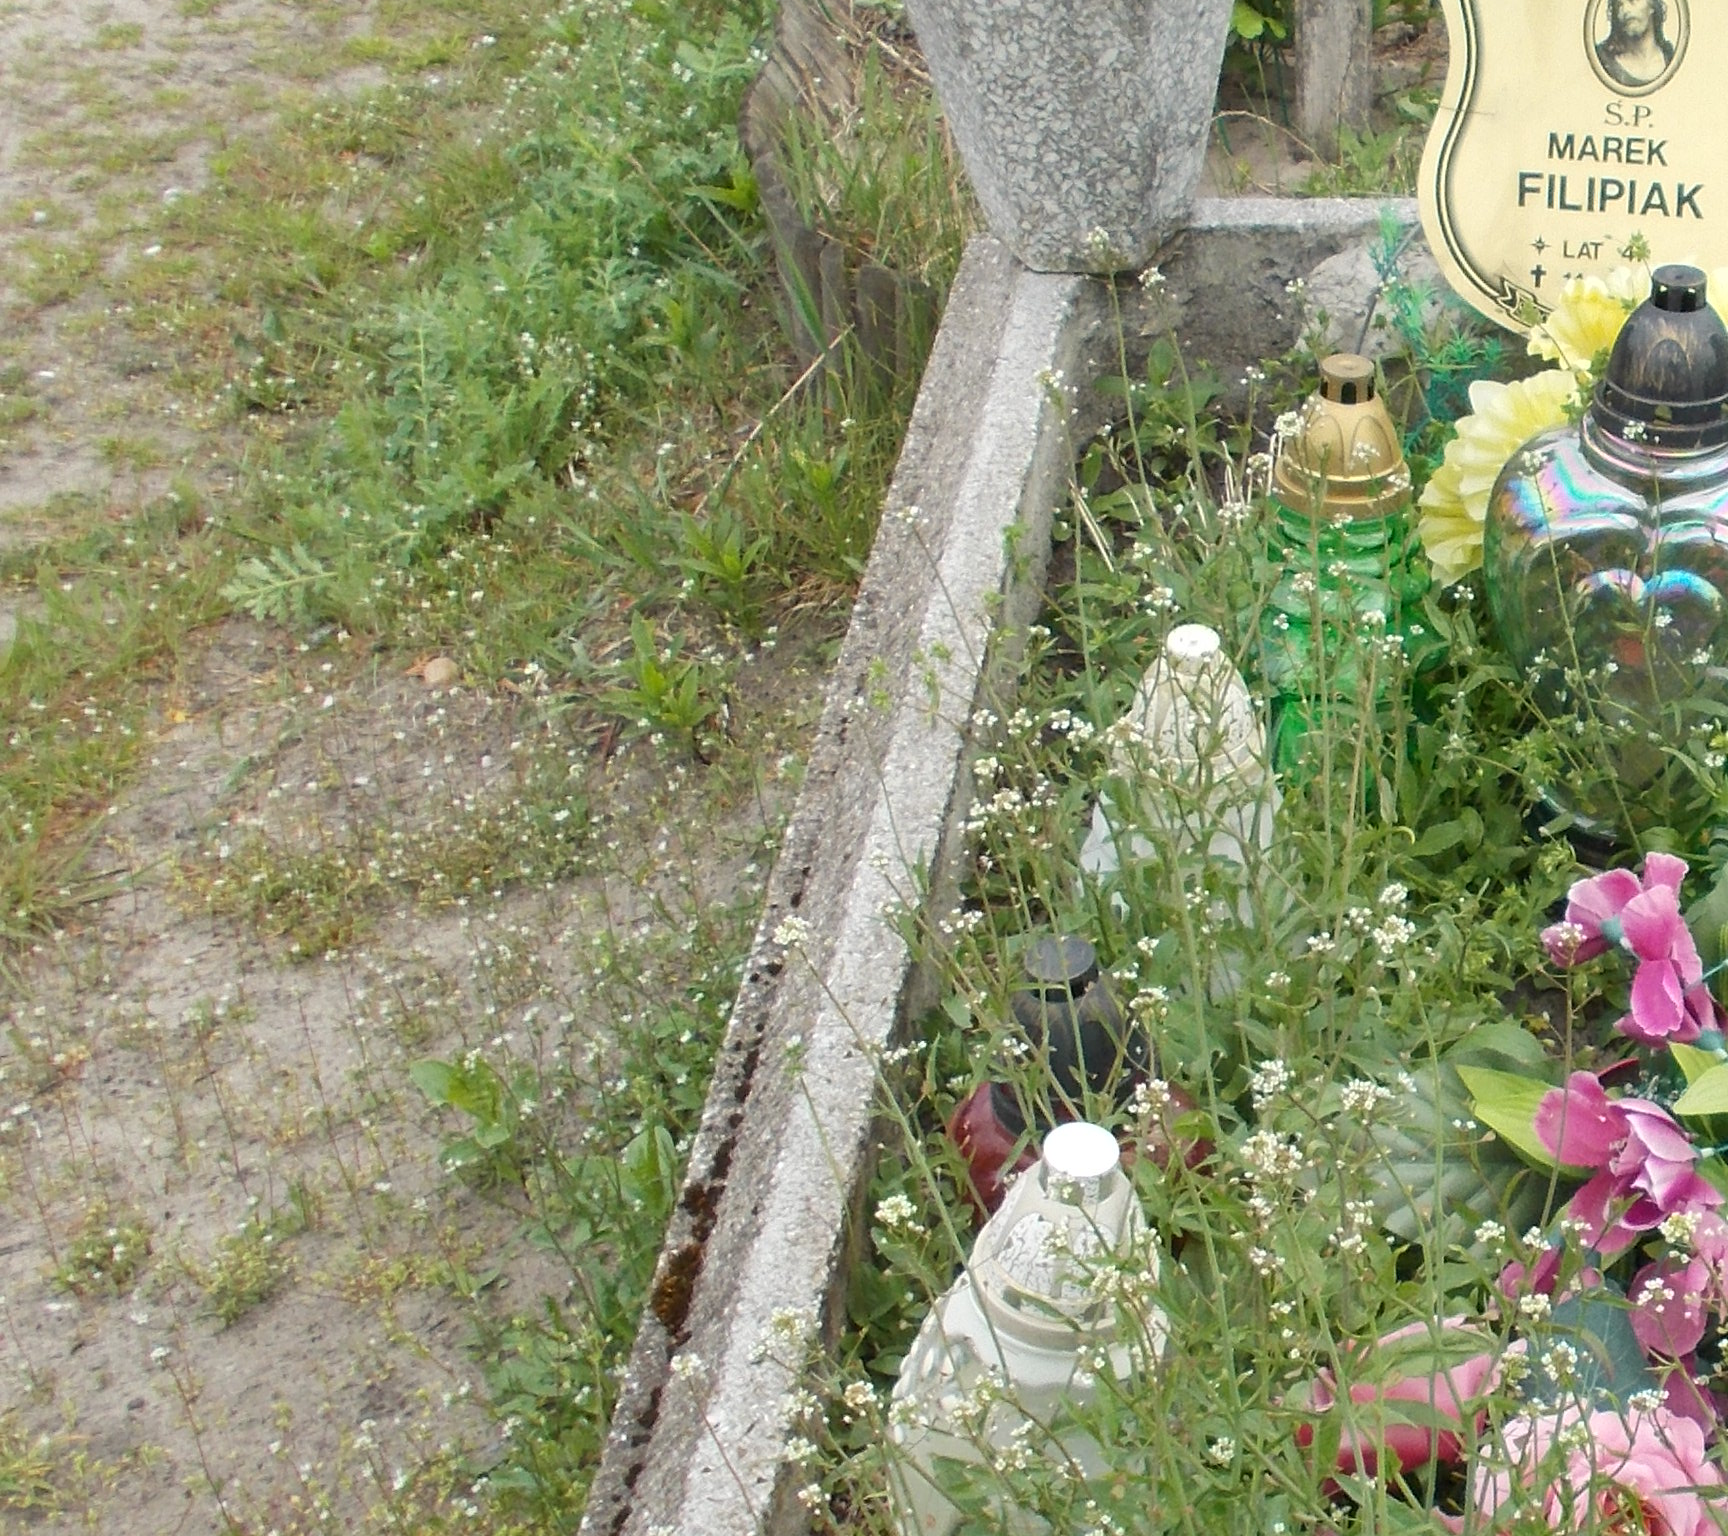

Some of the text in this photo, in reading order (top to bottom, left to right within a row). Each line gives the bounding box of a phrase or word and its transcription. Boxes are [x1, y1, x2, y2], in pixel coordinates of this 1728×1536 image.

[1547, 131, 1669, 167] MAREK
[1517, 171, 1705, 220] FILIPIAK
[1563, 240, 1604, 260] LAT
